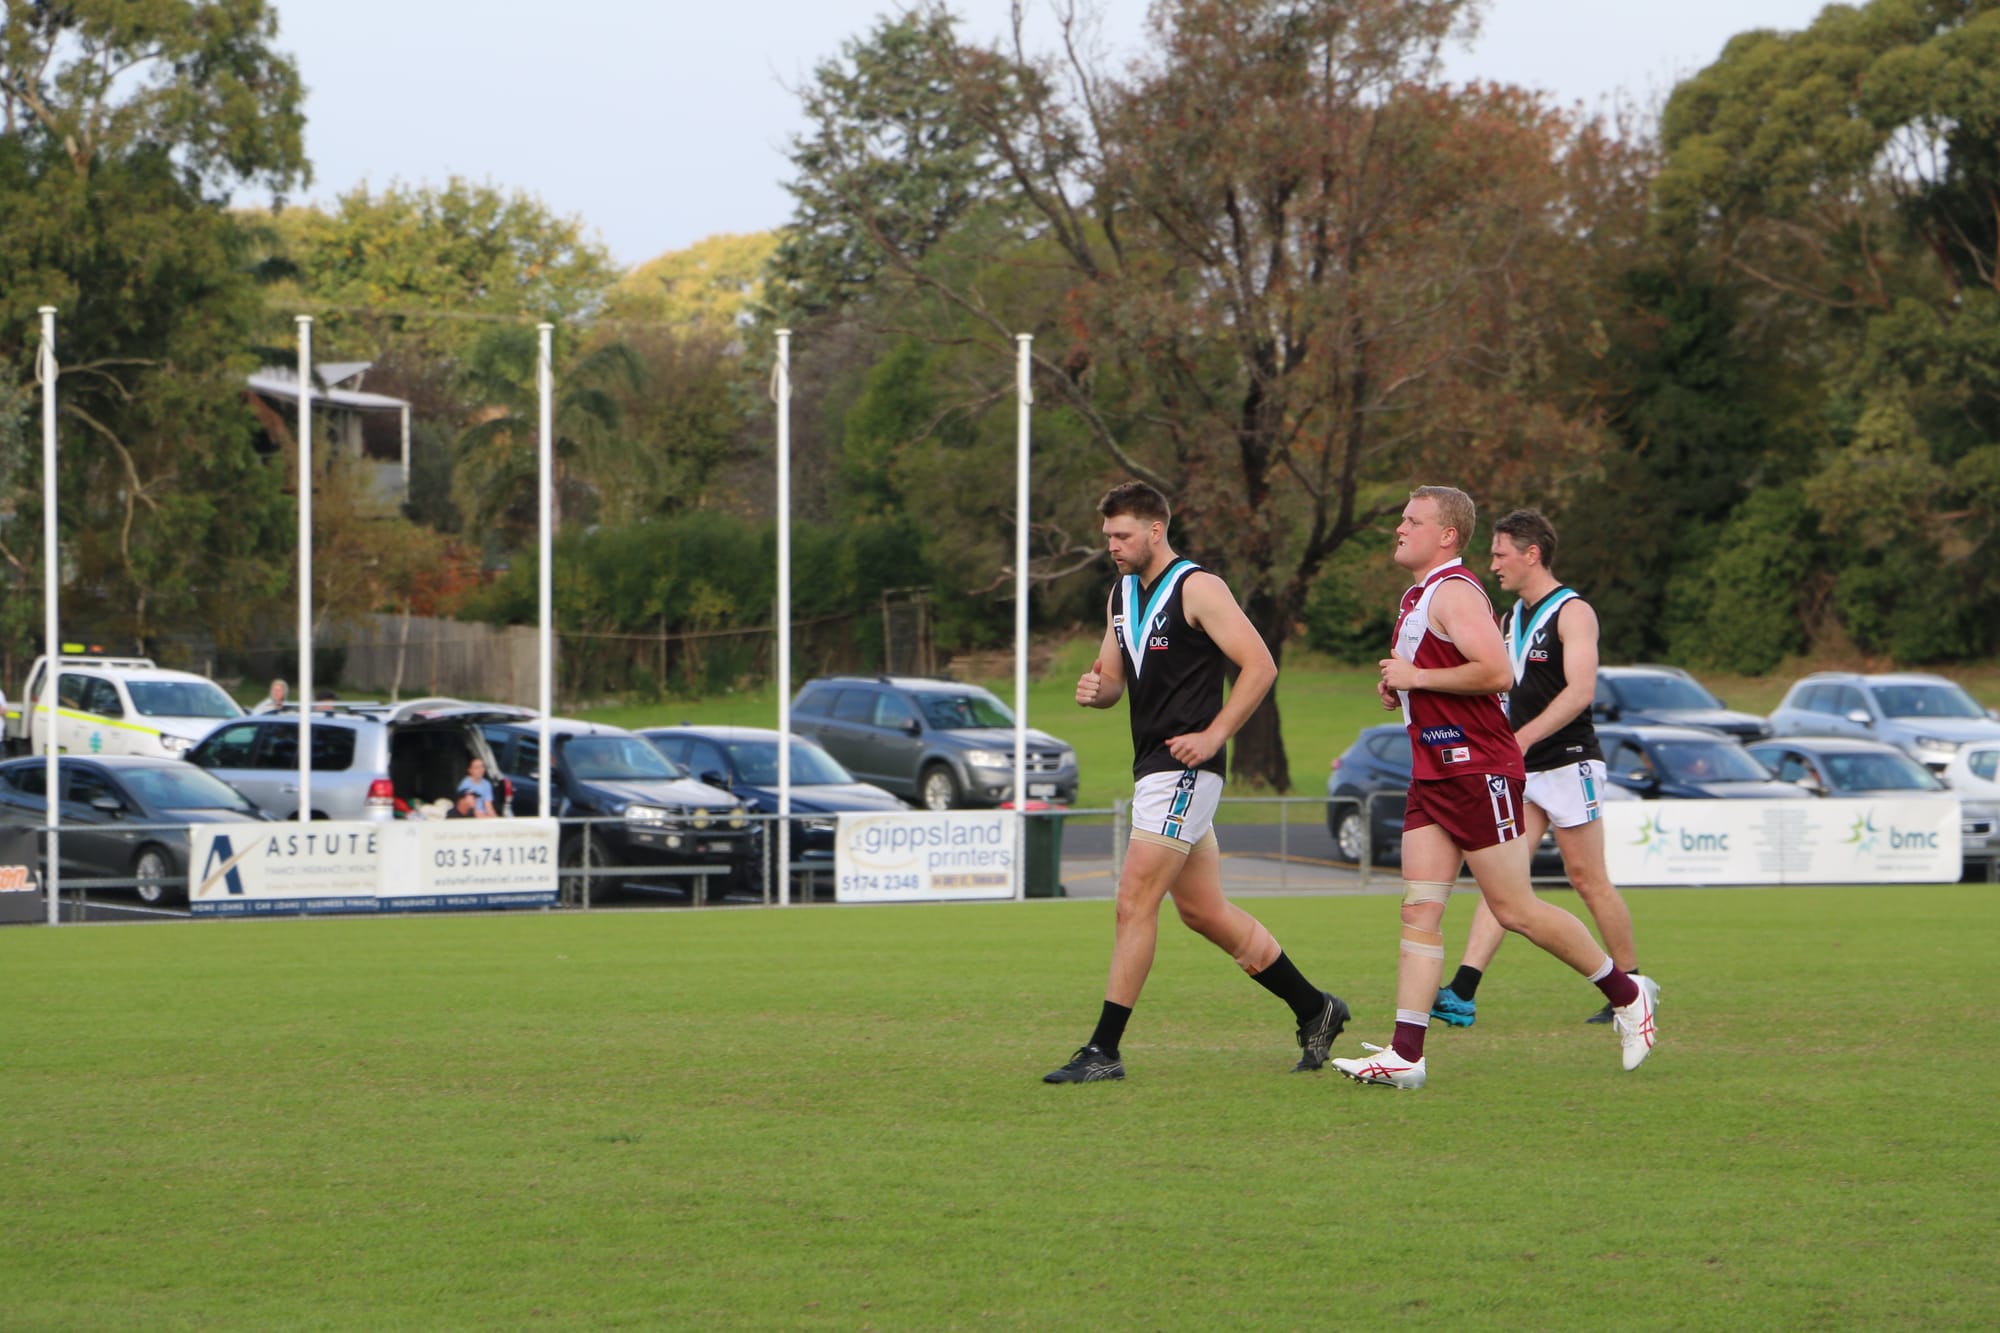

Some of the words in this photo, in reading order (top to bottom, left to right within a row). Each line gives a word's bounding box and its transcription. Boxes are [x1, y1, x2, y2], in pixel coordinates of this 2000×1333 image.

[266, 833, 377, 857] ASTUTE
[865, 820, 1002, 854] gippsland
[1681, 827, 1729, 851] bmc
[1890, 826, 1939, 850] bmc
[434, 849, 456, 867] 03
[508, 846, 549, 865] 1142
[928, 847, 1011, 871] printers
[841, 874, 879, 891] 5174
[884, 874, 920, 890] 2348
